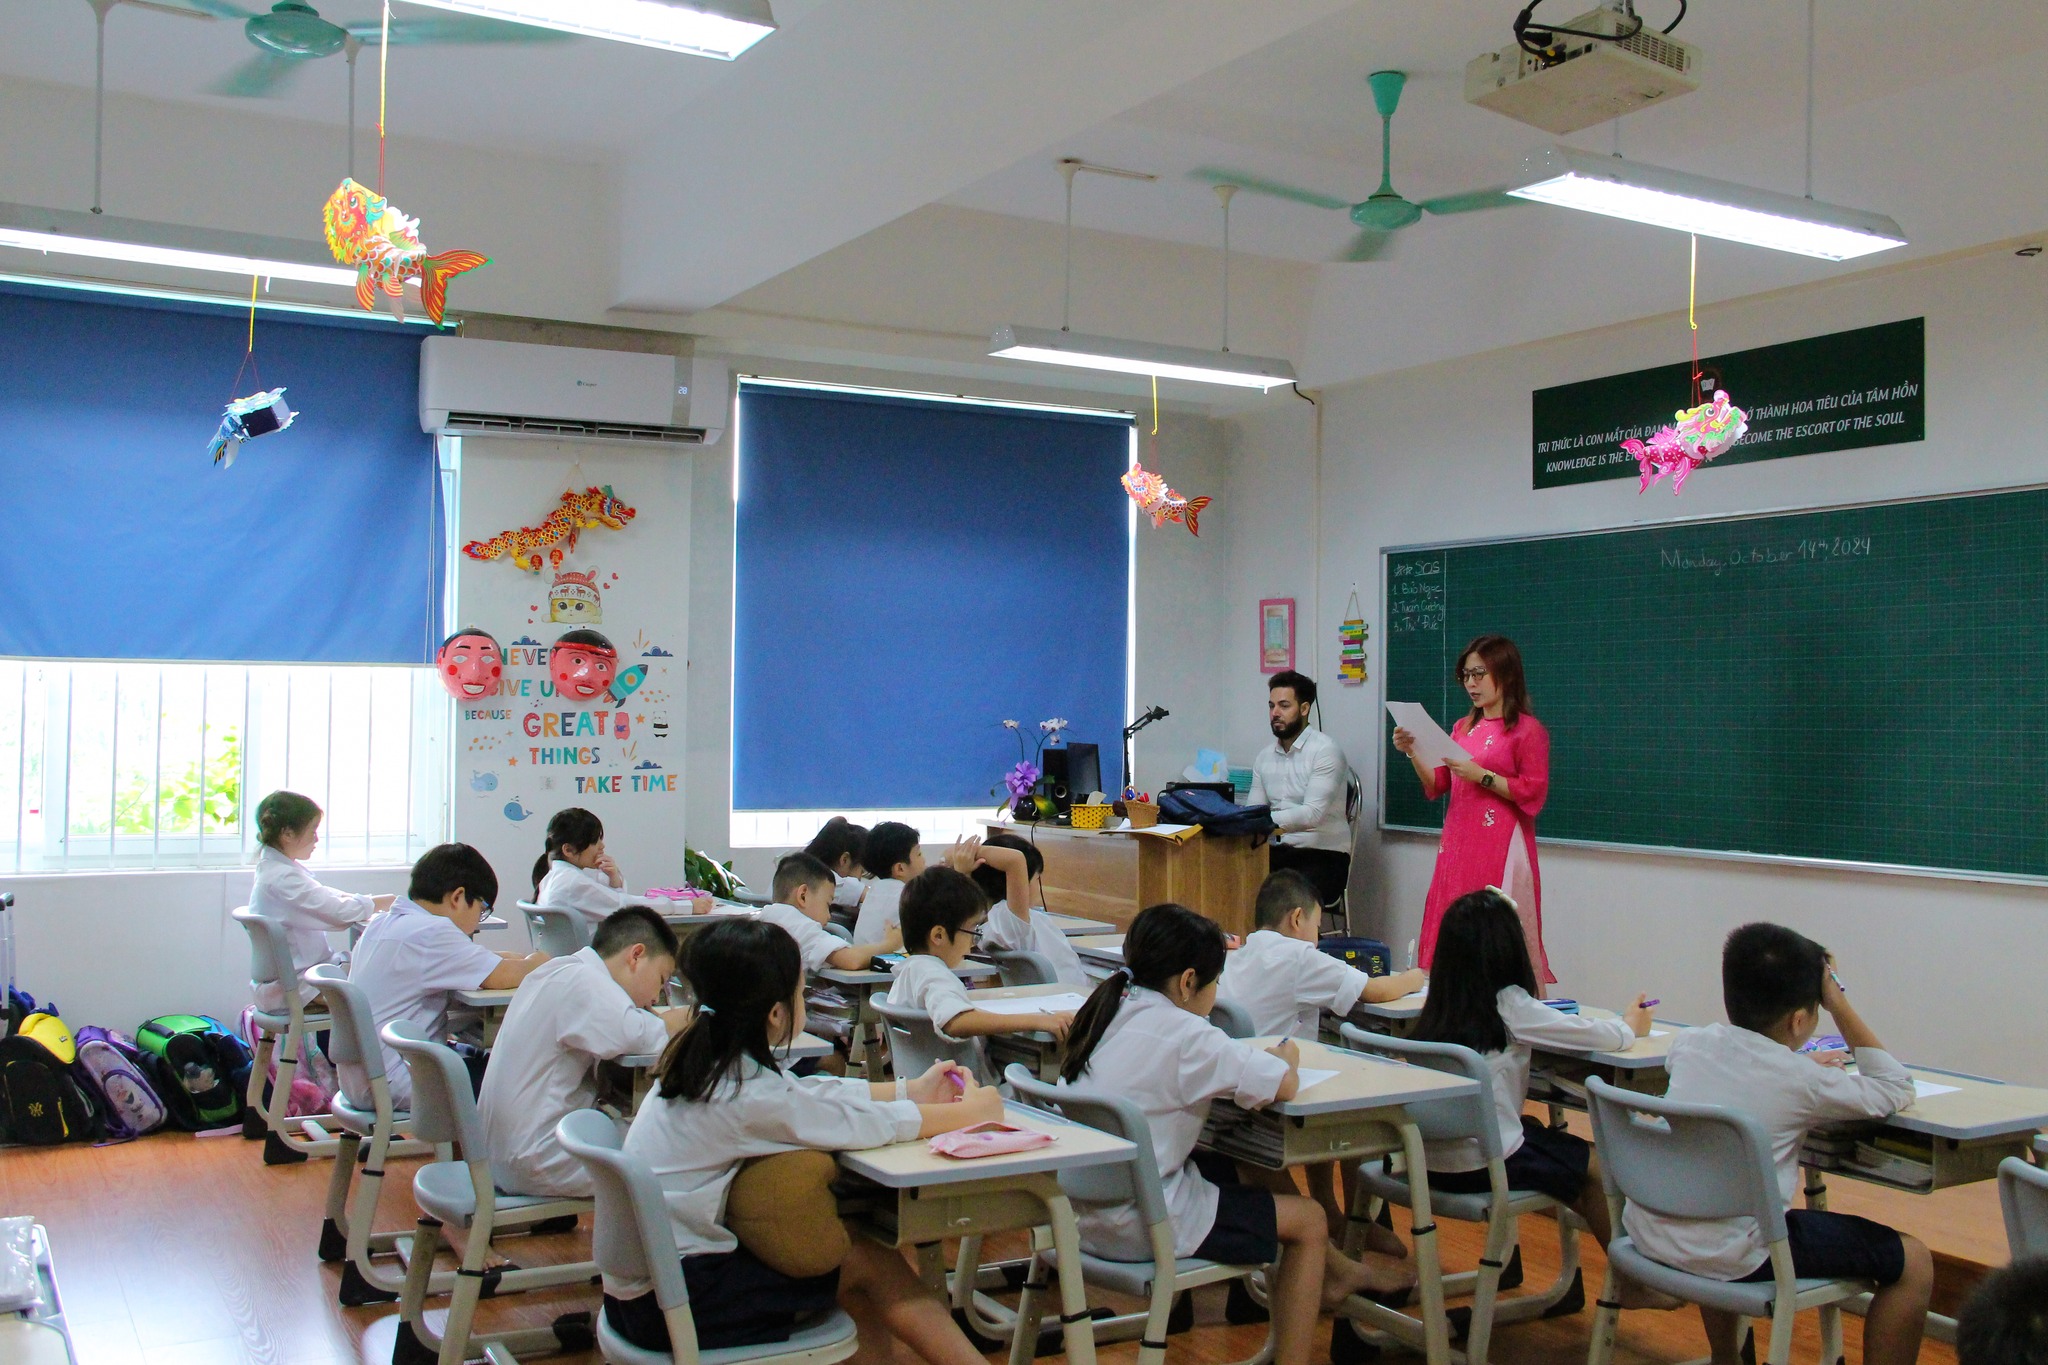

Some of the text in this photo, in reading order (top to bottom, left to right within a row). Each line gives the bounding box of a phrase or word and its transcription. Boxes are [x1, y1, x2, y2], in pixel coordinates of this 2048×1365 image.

[678, 386, 688, 395] 28
[1537, 442, 1550, 454] TRI
[1551, 432, 1573, 450] THỨC
[1573, 432, 1584, 448] LÀ
[1585, 432, 1603, 446] CON
[1605, 426, 1624, 443] MẮT
[1624, 426, 1643, 440] CỦA
[1756, 403, 1789, 420] THÀNH
[1791, 400, 1813, 416] HOA
[1816, 394, 1838, 411] TIÊU
[1841, 389, 1862, 407] CỦA
[1866, 386, 1889, 403] TÂM
[1891, 380, 1918, 400] HỒN
[1546, 456, 1597, 473] KNOWLEDGE
[1598, 454, 1606, 465] IS
[1608, 451, 1624, 464] THE
[1776, 426, 1793, 441] THE
[1795, 421, 1834, 437] ESCORT
[1836, 418, 1851, 431] OF
[1853, 415, 1873, 430] THE
[1875, 411, 1905, 426] SOUL
[1730, 548, 1793, 565] October
[1832, 537, 1870, 556] 2024
[1415, 560, 1440, 576] SOS
[490, 679, 532, 697] IVE
[465, 709, 512, 720] BECAUSE
[523, 711, 608, 737] GREAT
[529, 747, 600, 765] THINGS
[575, 774, 677, 793] TAKE TIME
